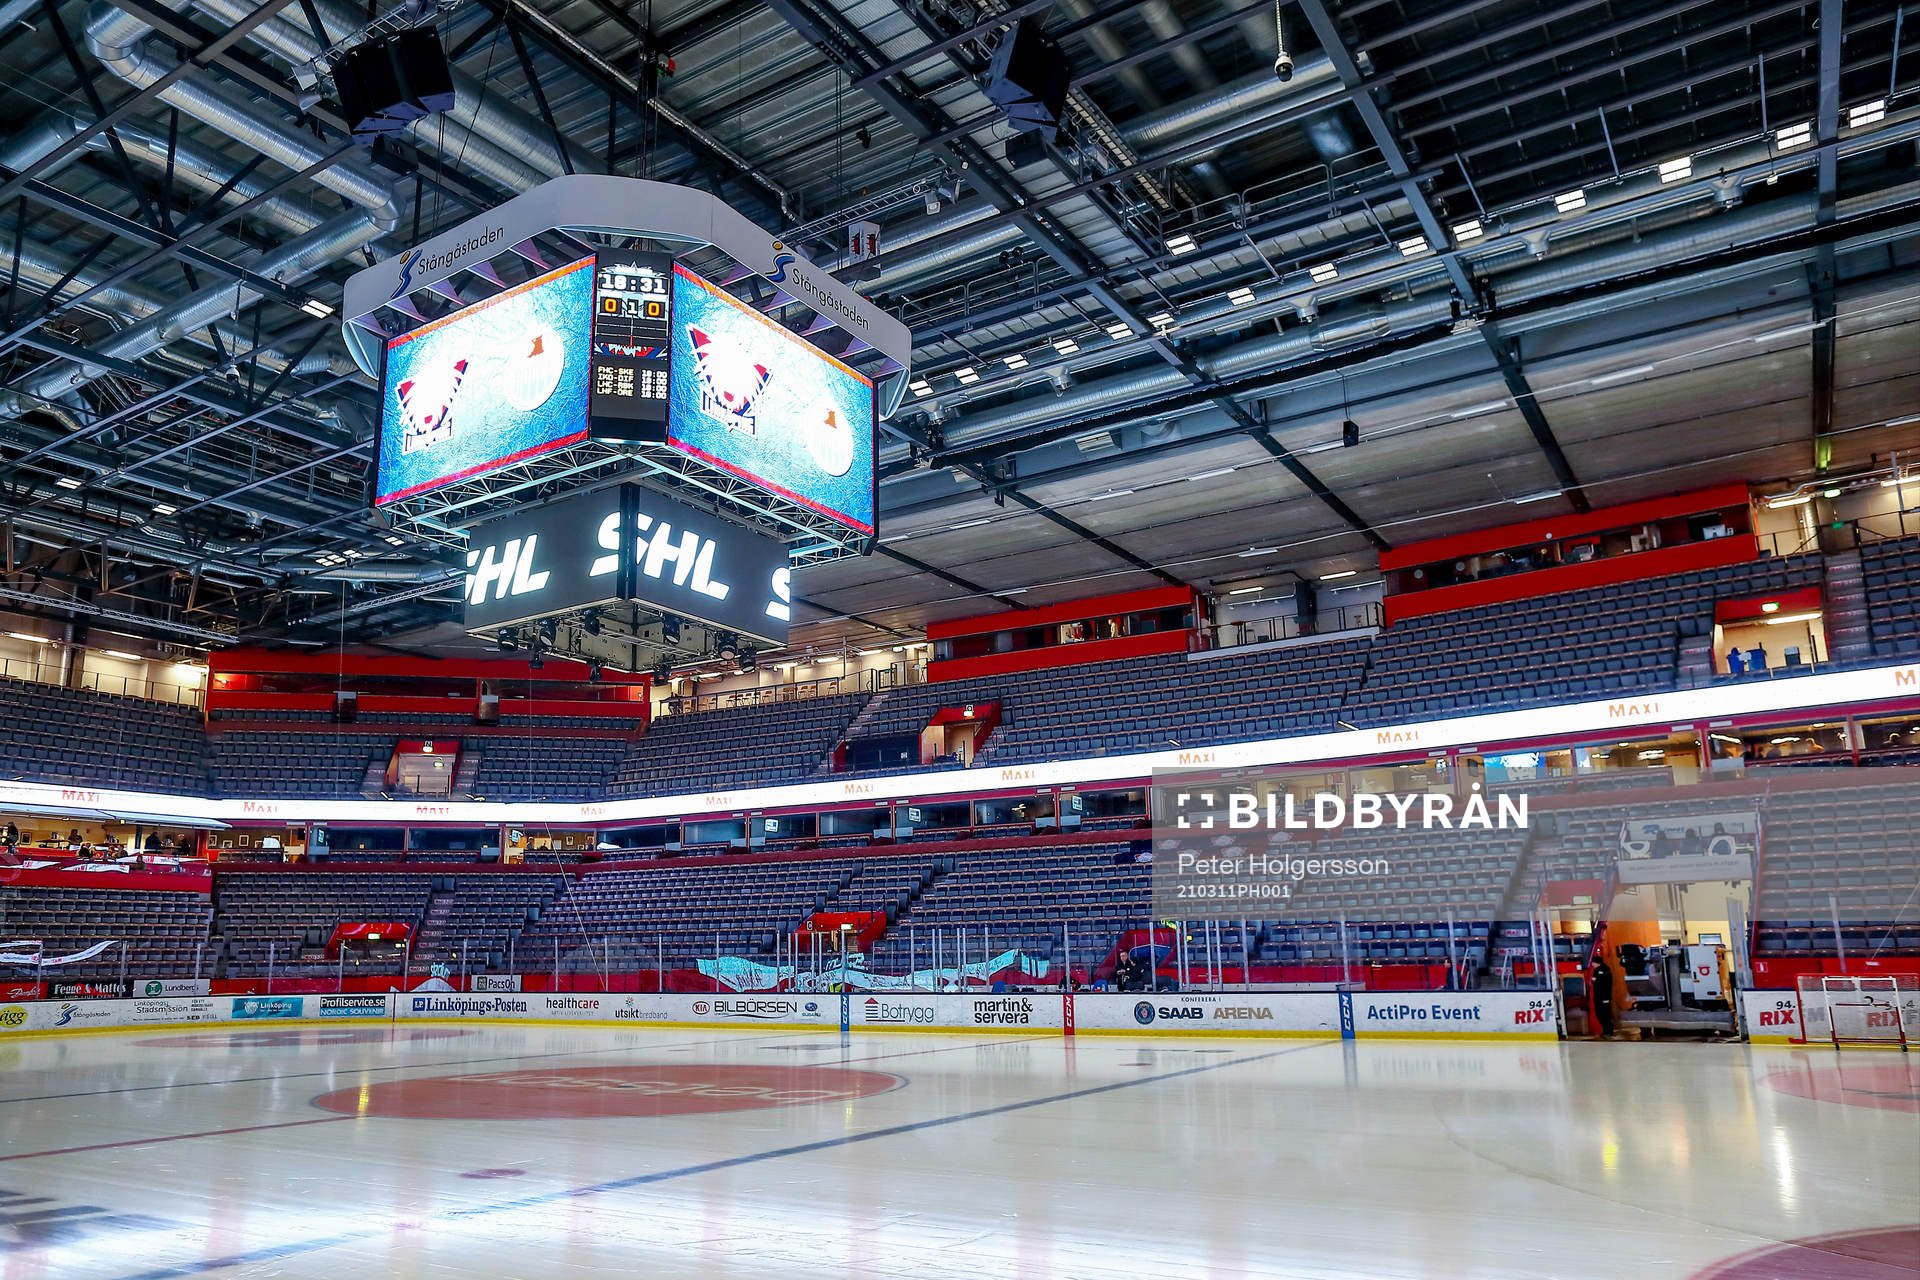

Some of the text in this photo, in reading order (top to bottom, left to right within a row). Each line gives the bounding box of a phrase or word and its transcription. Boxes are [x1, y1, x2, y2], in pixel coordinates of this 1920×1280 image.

[418, 226, 505, 275] Stångåstaden
[601, 273, 666, 294] 18:31
[792, 268, 870, 331] Stångåstaden
[604, 298, 618, 313] 0
[647, 302, 660, 317] 0
[320, 996, 385, 1008] Profilservice.se
[425, 997, 528, 1015] Linköpings-Posten
[546, 997, 600, 1009] healthcare
[695, 1003, 707, 1012] KIA
[714, 998, 798, 1013] BILBÖRSEN
[974, 997, 1033, 1012] martin&
[1529, 1000, 1553, 1010] 94.4
[136, 1006, 188, 1014] Stadsmission
[881, 1003, 935, 1023] Botrygg
[974, 1011, 1029, 1024] servera
[1064, 995, 1073, 1028] CCM
[1158, 1007, 1274, 1020] SAAB ARENA
[1341, 994, 1351, 1031] CCM
[1367, 1004, 1481, 1020] ActiPro Event
